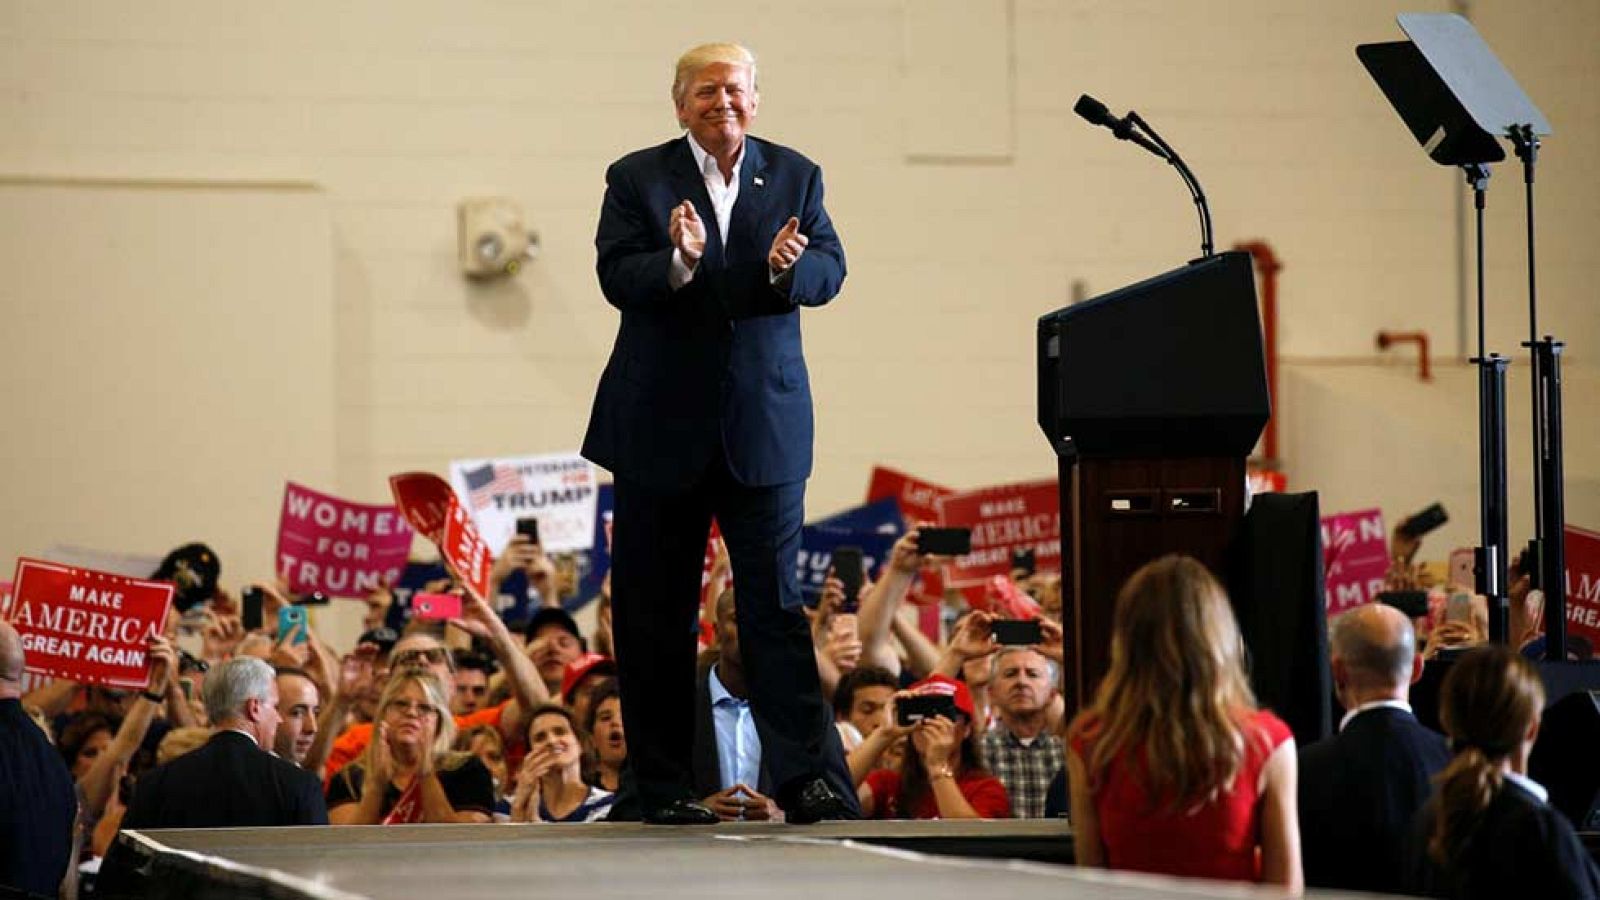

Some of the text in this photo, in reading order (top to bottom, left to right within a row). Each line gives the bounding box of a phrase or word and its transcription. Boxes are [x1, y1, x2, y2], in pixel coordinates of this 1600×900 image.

[493, 486, 592, 510] TRUMP
[978, 497, 1026, 518] MAKE
[316, 536, 370, 561] FOR
[954, 546, 1010, 570] GREAT
[280, 552, 400, 593] TRUMP
[69, 584, 125, 610] MAKE
[14, 600, 162, 646] AMERICA
[21, 632, 146, 668] GREAT AGAIN
